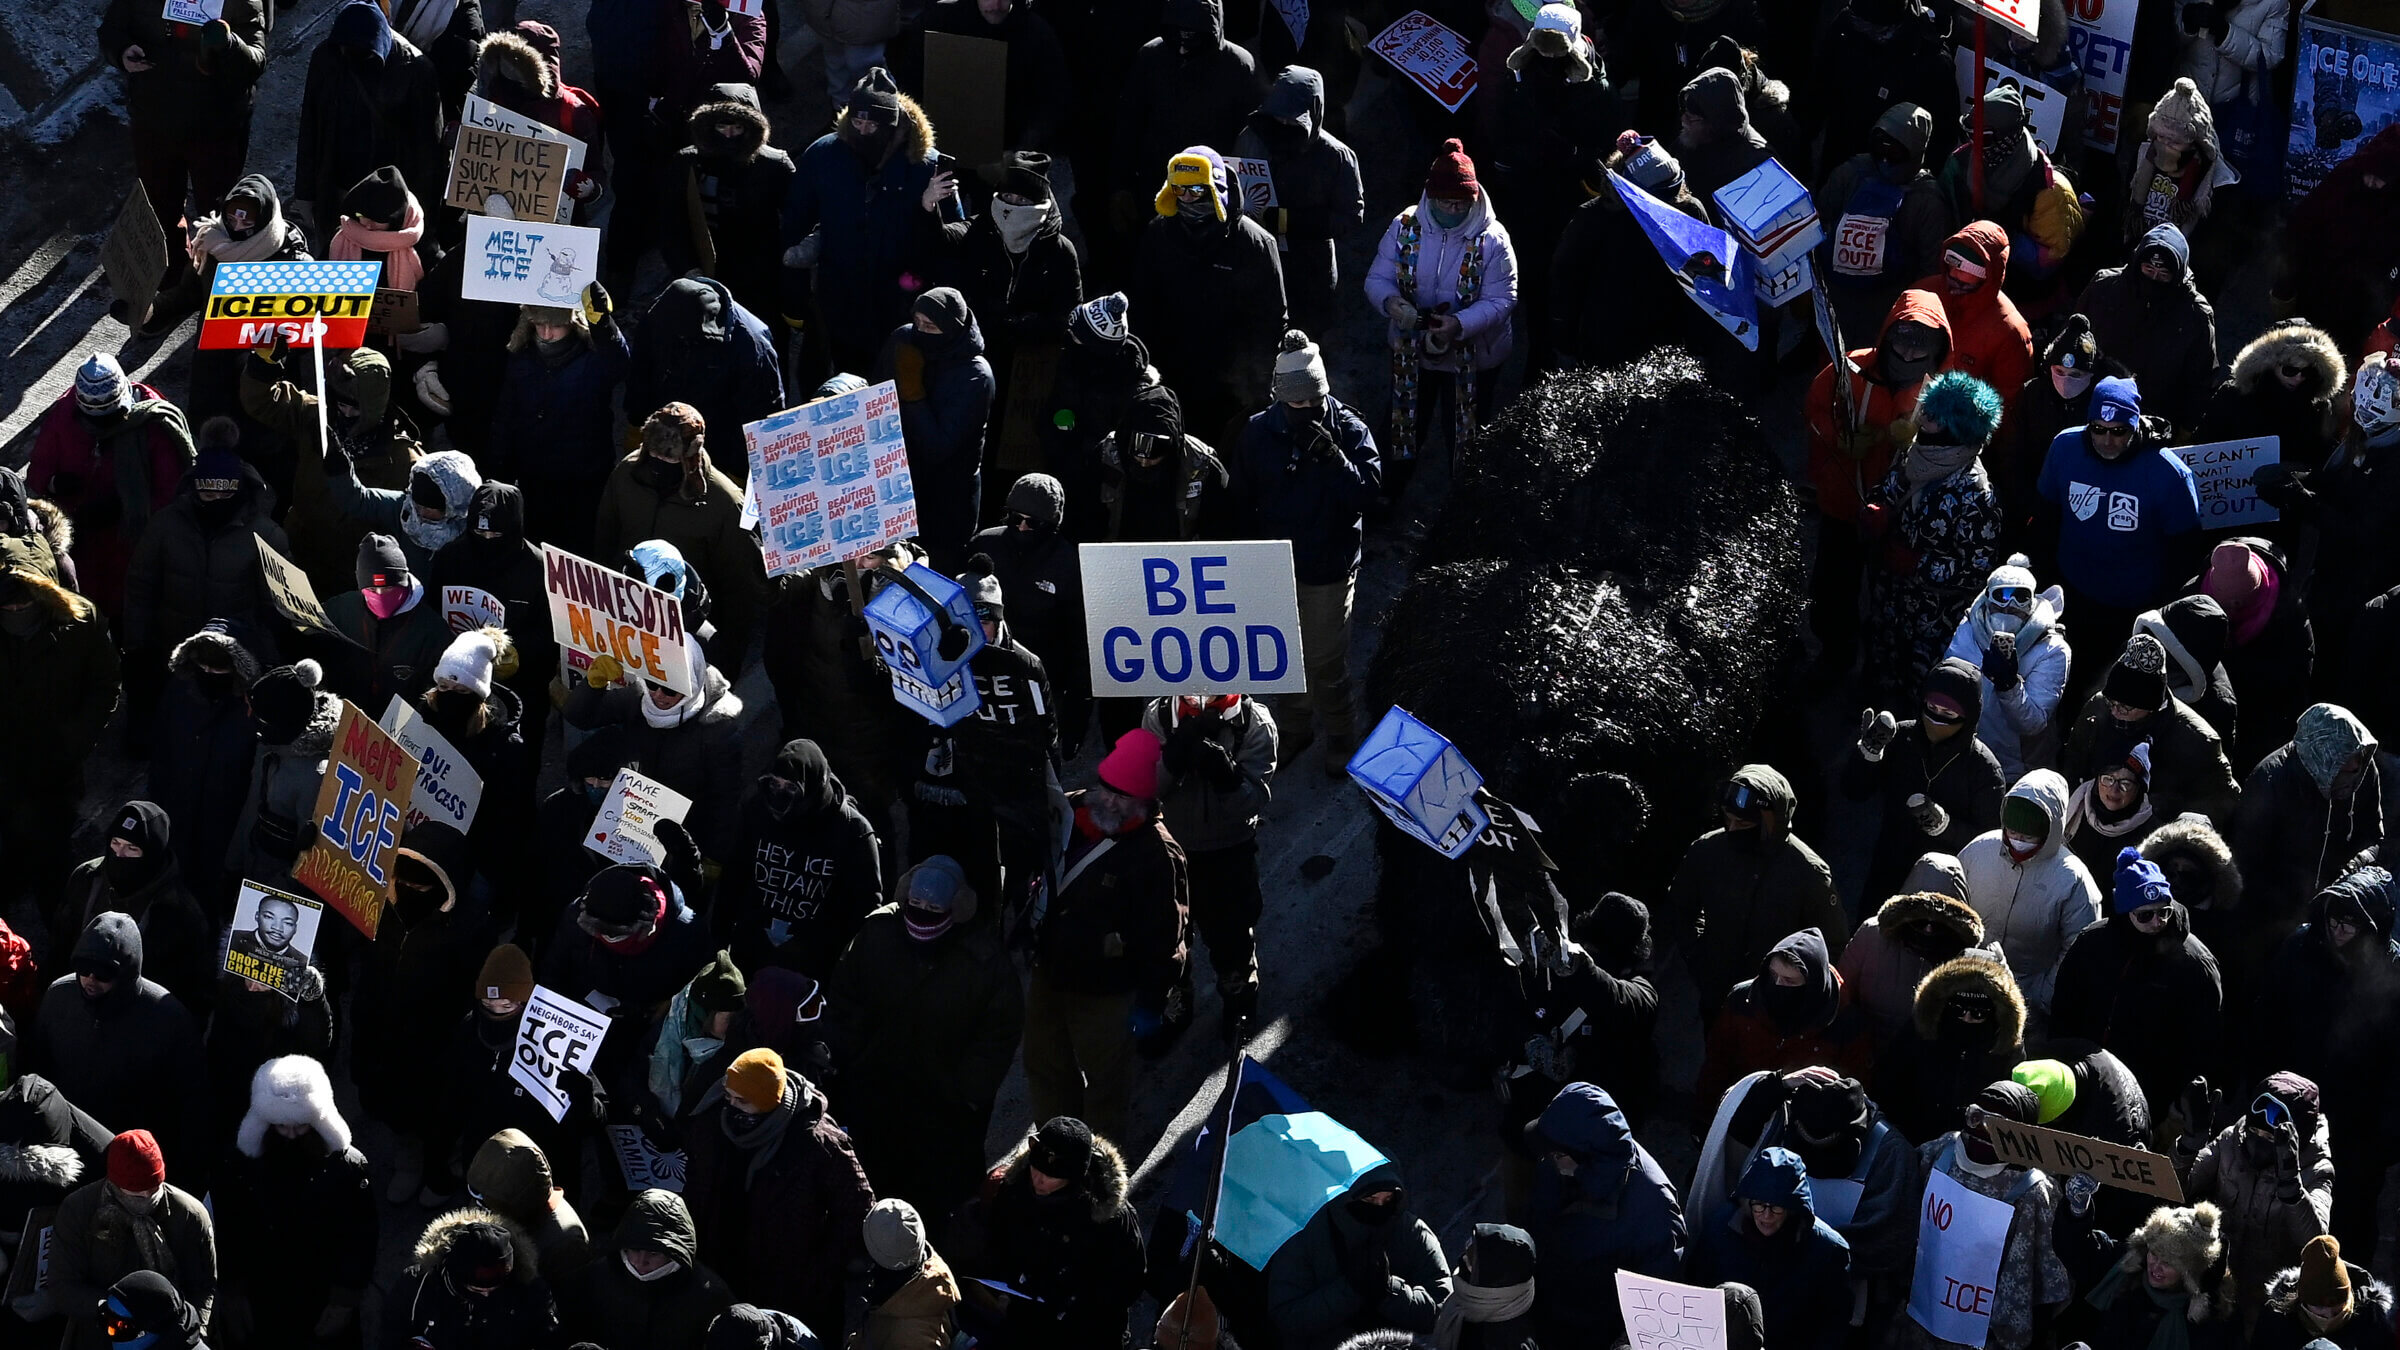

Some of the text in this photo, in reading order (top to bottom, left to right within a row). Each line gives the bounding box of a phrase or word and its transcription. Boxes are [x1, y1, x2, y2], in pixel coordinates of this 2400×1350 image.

[1397, 27, 1444, 64] MINNEAPOLIS
[1426, 37, 1444, 52] OUT
[2309, 43, 2399, 88] ICE Out
[466, 132, 550, 168] HEY ICE
[459, 158, 547, 192] SUCK MY
[1238, 162, 1269, 178] ARE
[485, 230, 544, 256] MELT
[1840, 229, 1877, 251] ICE
[484, 253, 532, 281] ICE
[1838, 248, 1877, 267] OUT!
[210, 295, 371, 318] ICE OUT
[238, 321, 328, 345] MSP
[865, 392, 897, 411] BEAUTI
[866, 406, 884, 420] DAY
[817, 425, 865, 449] BEAUTIFUL
[868, 414, 901, 441] IC
[763, 431, 812, 456] BEAUTIFUL
[788, 438, 812, 455] MELT
[818, 445, 835, 458] DAY
[2204, 445, 2260, 464] CAN'T
[766, 449, 816, 487] ICE
[820, 441, 870, 480] ICE
[874, 448, 906, 468] BEAUTI
[876, 464, 893, 479] DAY
[2195, 465, 2232, 478] WAIT
[827, 485, 876, 511] BEAUTIFUL
[879, 473, 911, 500] IC
[2200, 476, 2256, 494] SPRIN
[770, 491, 819, 517] BEAUTIFUL
[771, 500, 820, 527] DAY MELT
[828, 506, 846, 520] DAY
[2211, 497, 2259, 516] OUT
[773, 511, 824, 547] ICE
[831, 504, 880, 540] ICE
[884, 510, 916, 529] BEAUTI
[885, 524, 903, 538] DAY
[842, 540, 885, 561] BEAUTIFU
[546, 551, 684, 647] MINNESOTA
[1142, 556, 1236, 615] BE
[447, 590, 503, 623] WE ARE
[606, 618, 668, 682] ICE
[1103, 625, 1288, 683] GOOD
[973, 674, 1014, 696] CE
[968, 703, 1019, 725] UT
[343, 713, 403, 791] Melt
[421, 746, 451, 780] DUE
[416, 767, 467, 821] PROCESS
[619, 773, 661, 798] MAKE
[623, 809, 644, 824] KIND
[627, 801, 660, 821] SMART
[1476, 829, 1519, 852] UT
[756, 839, 834, 876] HEY ICE
[755, 861, 832, 899] DETAIN
[758, 885, 820, 919] THIS!
[227, 961, 281, 989] CHARGES
[229, 949, 260, 969] DROP
[263, 962, 285, 978] THE
[529, 1004, 598, 1042] NEIGHBORS SAY
[521, 1016, 588, 1071] ICE
[518, 1043, 563, 1082] OU
[616, 1128, 652, 1186] FAMILY
[1996, 1127, 2156, 1186] MN NO-ICE
[1927, 1192, 1953, 1231] NO
[1628, 1287, 1703, 1320] ICE
[1940, 1276, 1994, 1317] ICE
